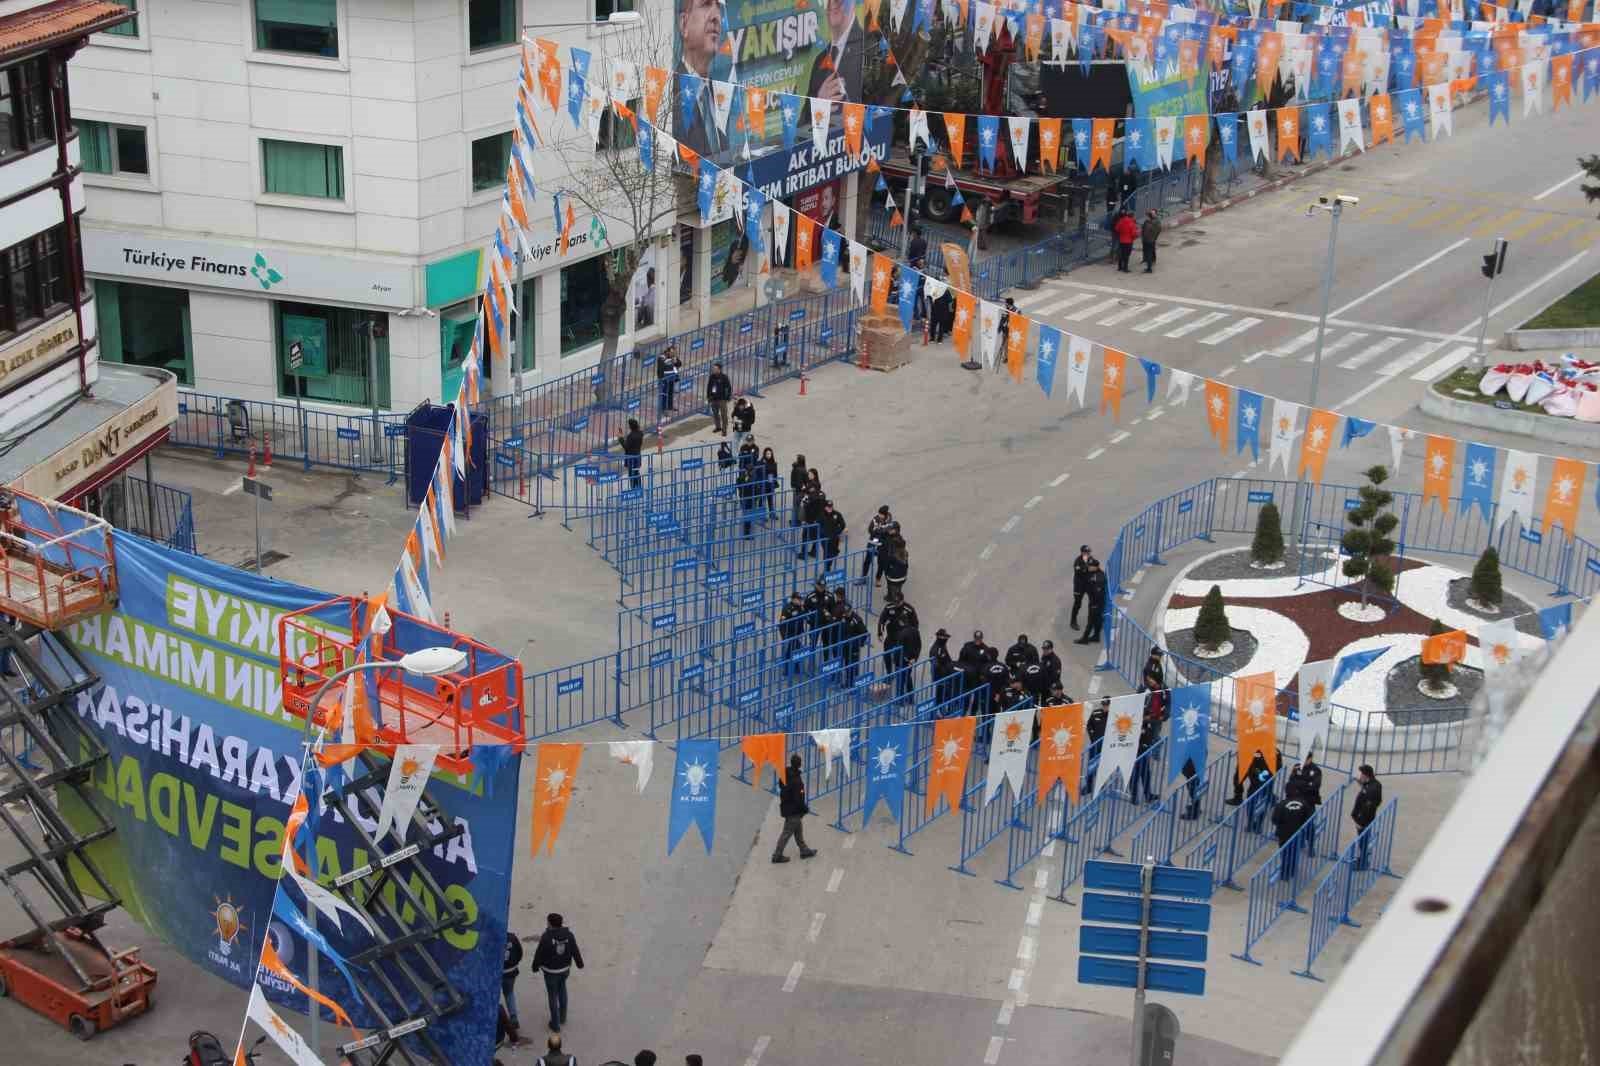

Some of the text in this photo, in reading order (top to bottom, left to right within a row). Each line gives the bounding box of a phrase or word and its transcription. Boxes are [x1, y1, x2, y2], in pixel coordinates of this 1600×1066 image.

[727, 11, 818, 64] YAKIŞIR
[788, 149, 808, 172] AK
[785, 160, 833, 194] İRTİBAT
[554, 232, 587, 253] Fans
[122, 248, 247, 276] Türkiye Finans
